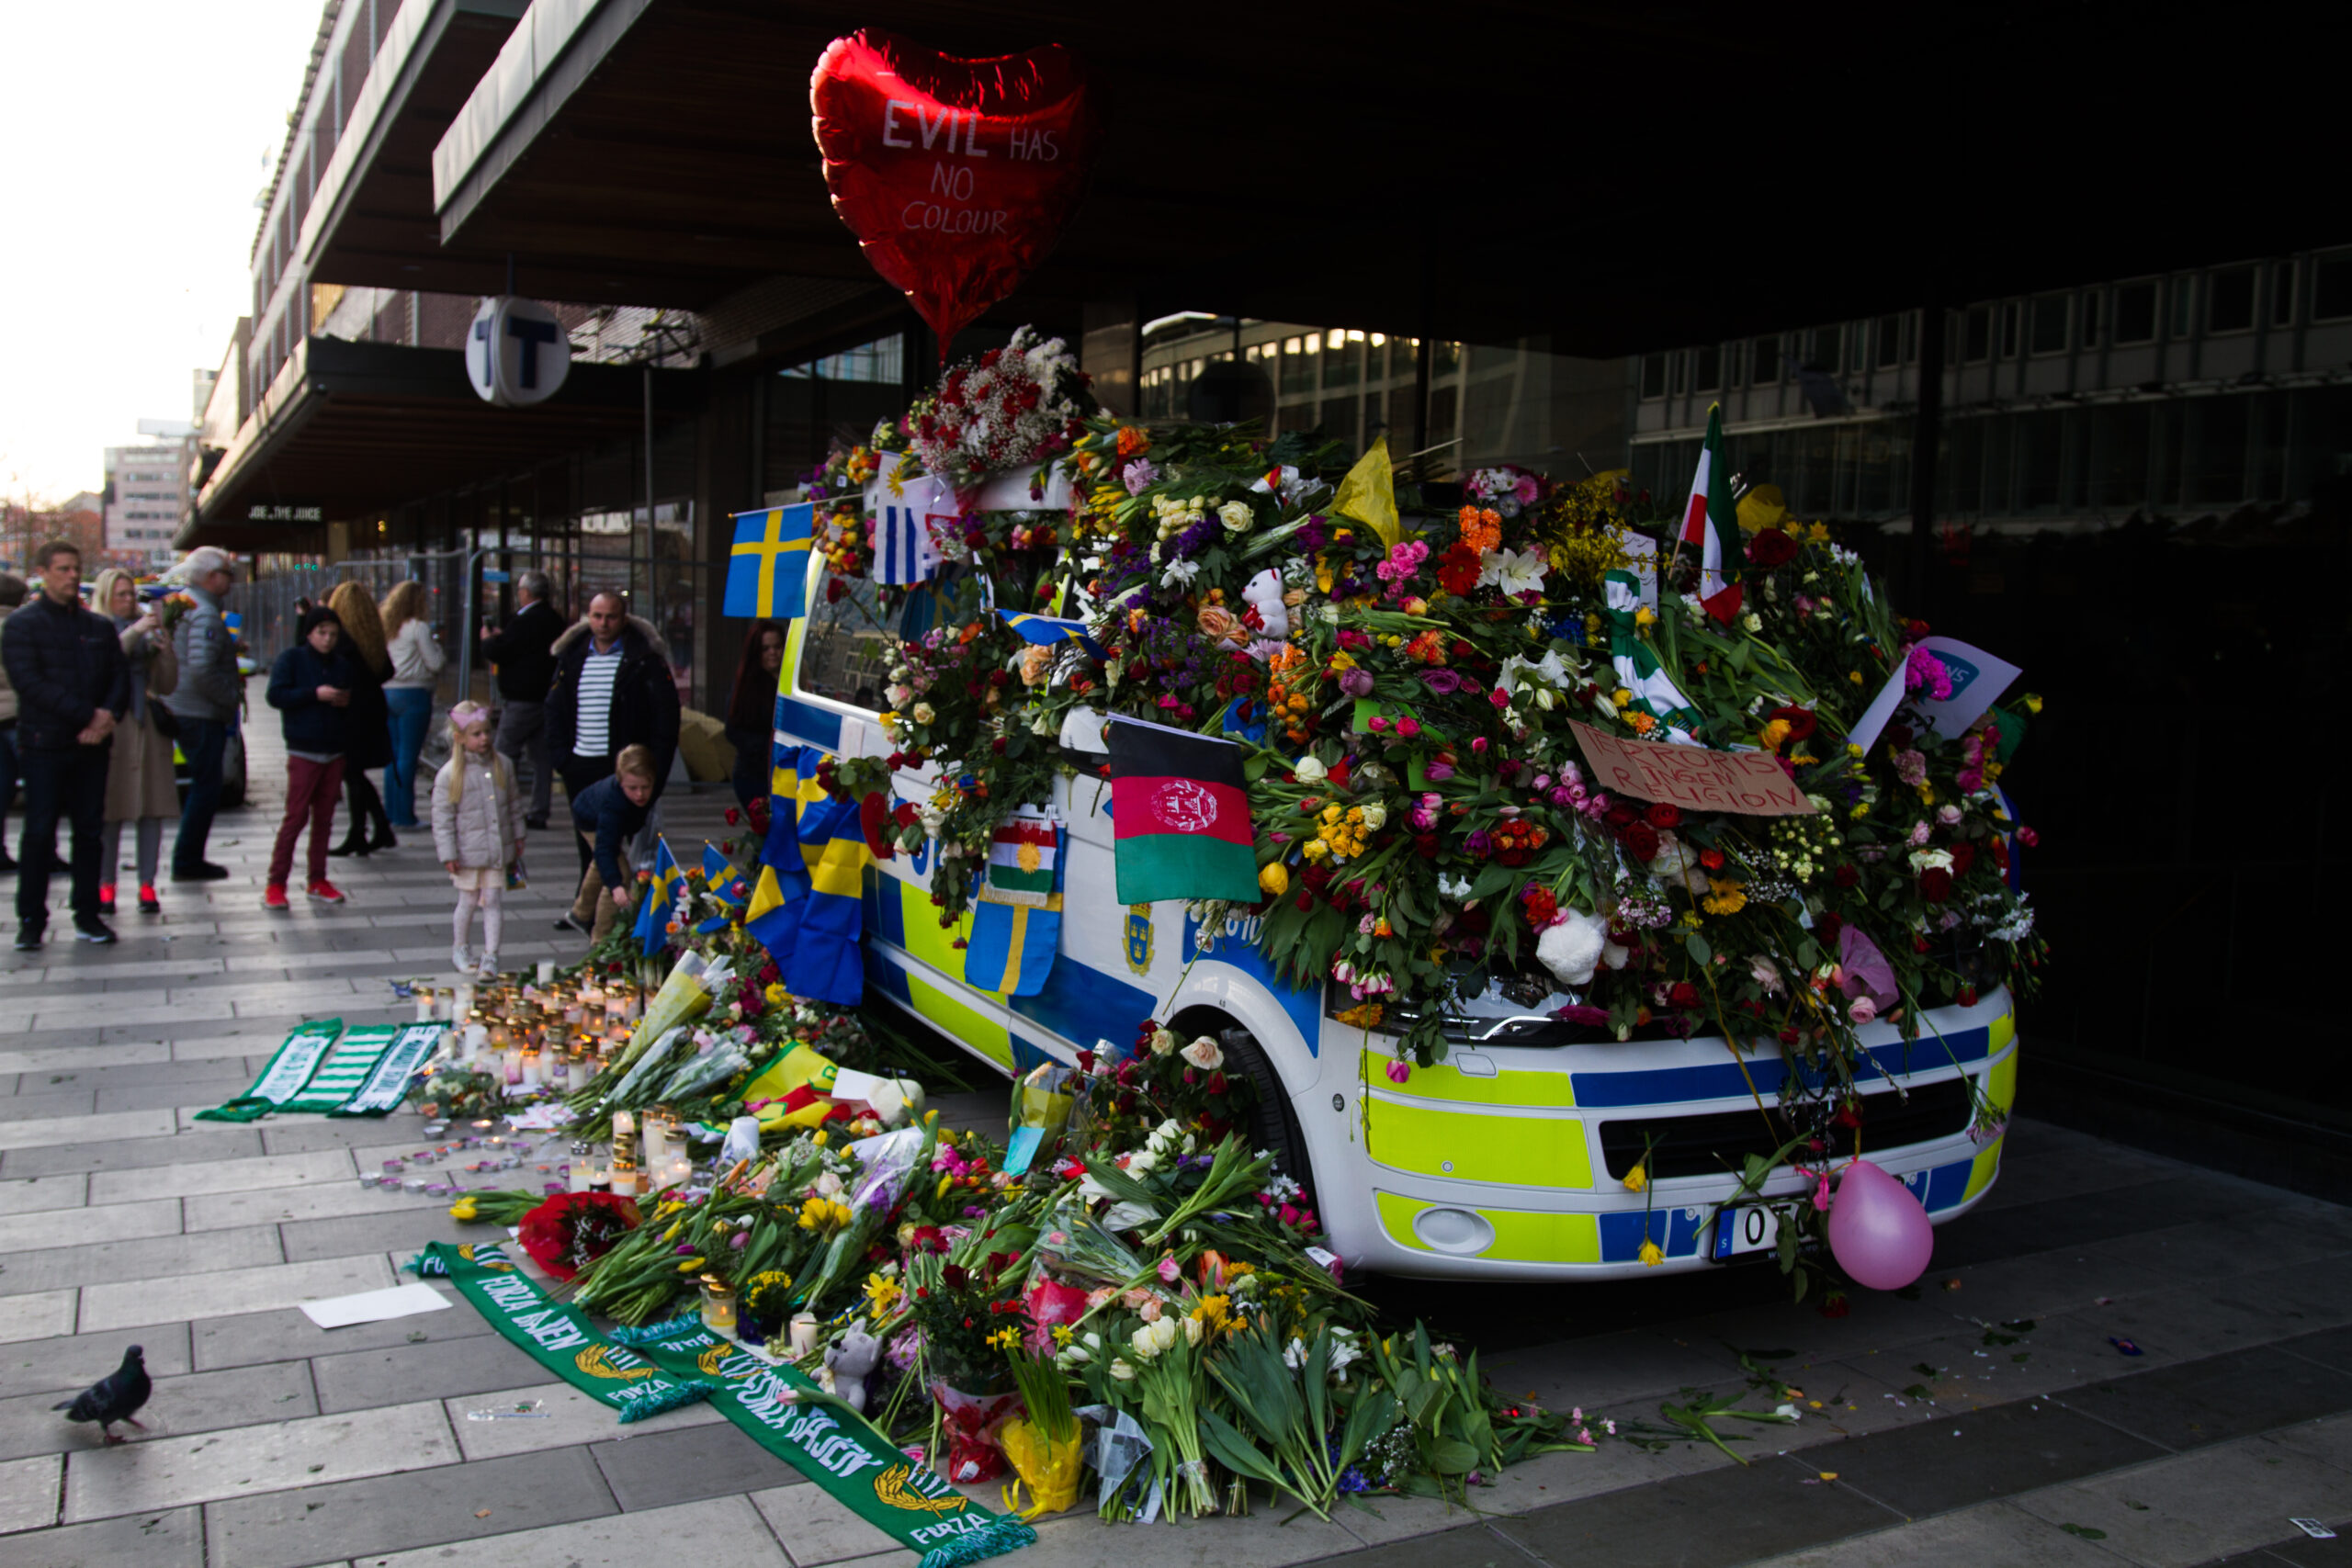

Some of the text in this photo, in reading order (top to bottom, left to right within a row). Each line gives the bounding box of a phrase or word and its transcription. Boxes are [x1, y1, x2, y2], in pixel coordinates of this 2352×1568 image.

[883, 98, 1059, 162] EVIL HAS
[931, 161, 974, 201] NO
[901, 201, 1009, 234] COLOUR
[506, 315, 557, 389] T
[248, 505, 268, 521] JOE
[274, 505, 293, 521] THE
[294, 506, 322, 522] JUICE
[1612, 766, 1798, 808] RELIGION
[1640, 765, 1735, 786] INGEN
[475, 1274, 543, 1314] FORZA
[605, 1379, 675, 1404] FORZA
[724, 1370, 798, 1430] FORZA
[909, 1512, 992, 1545] FORZA
